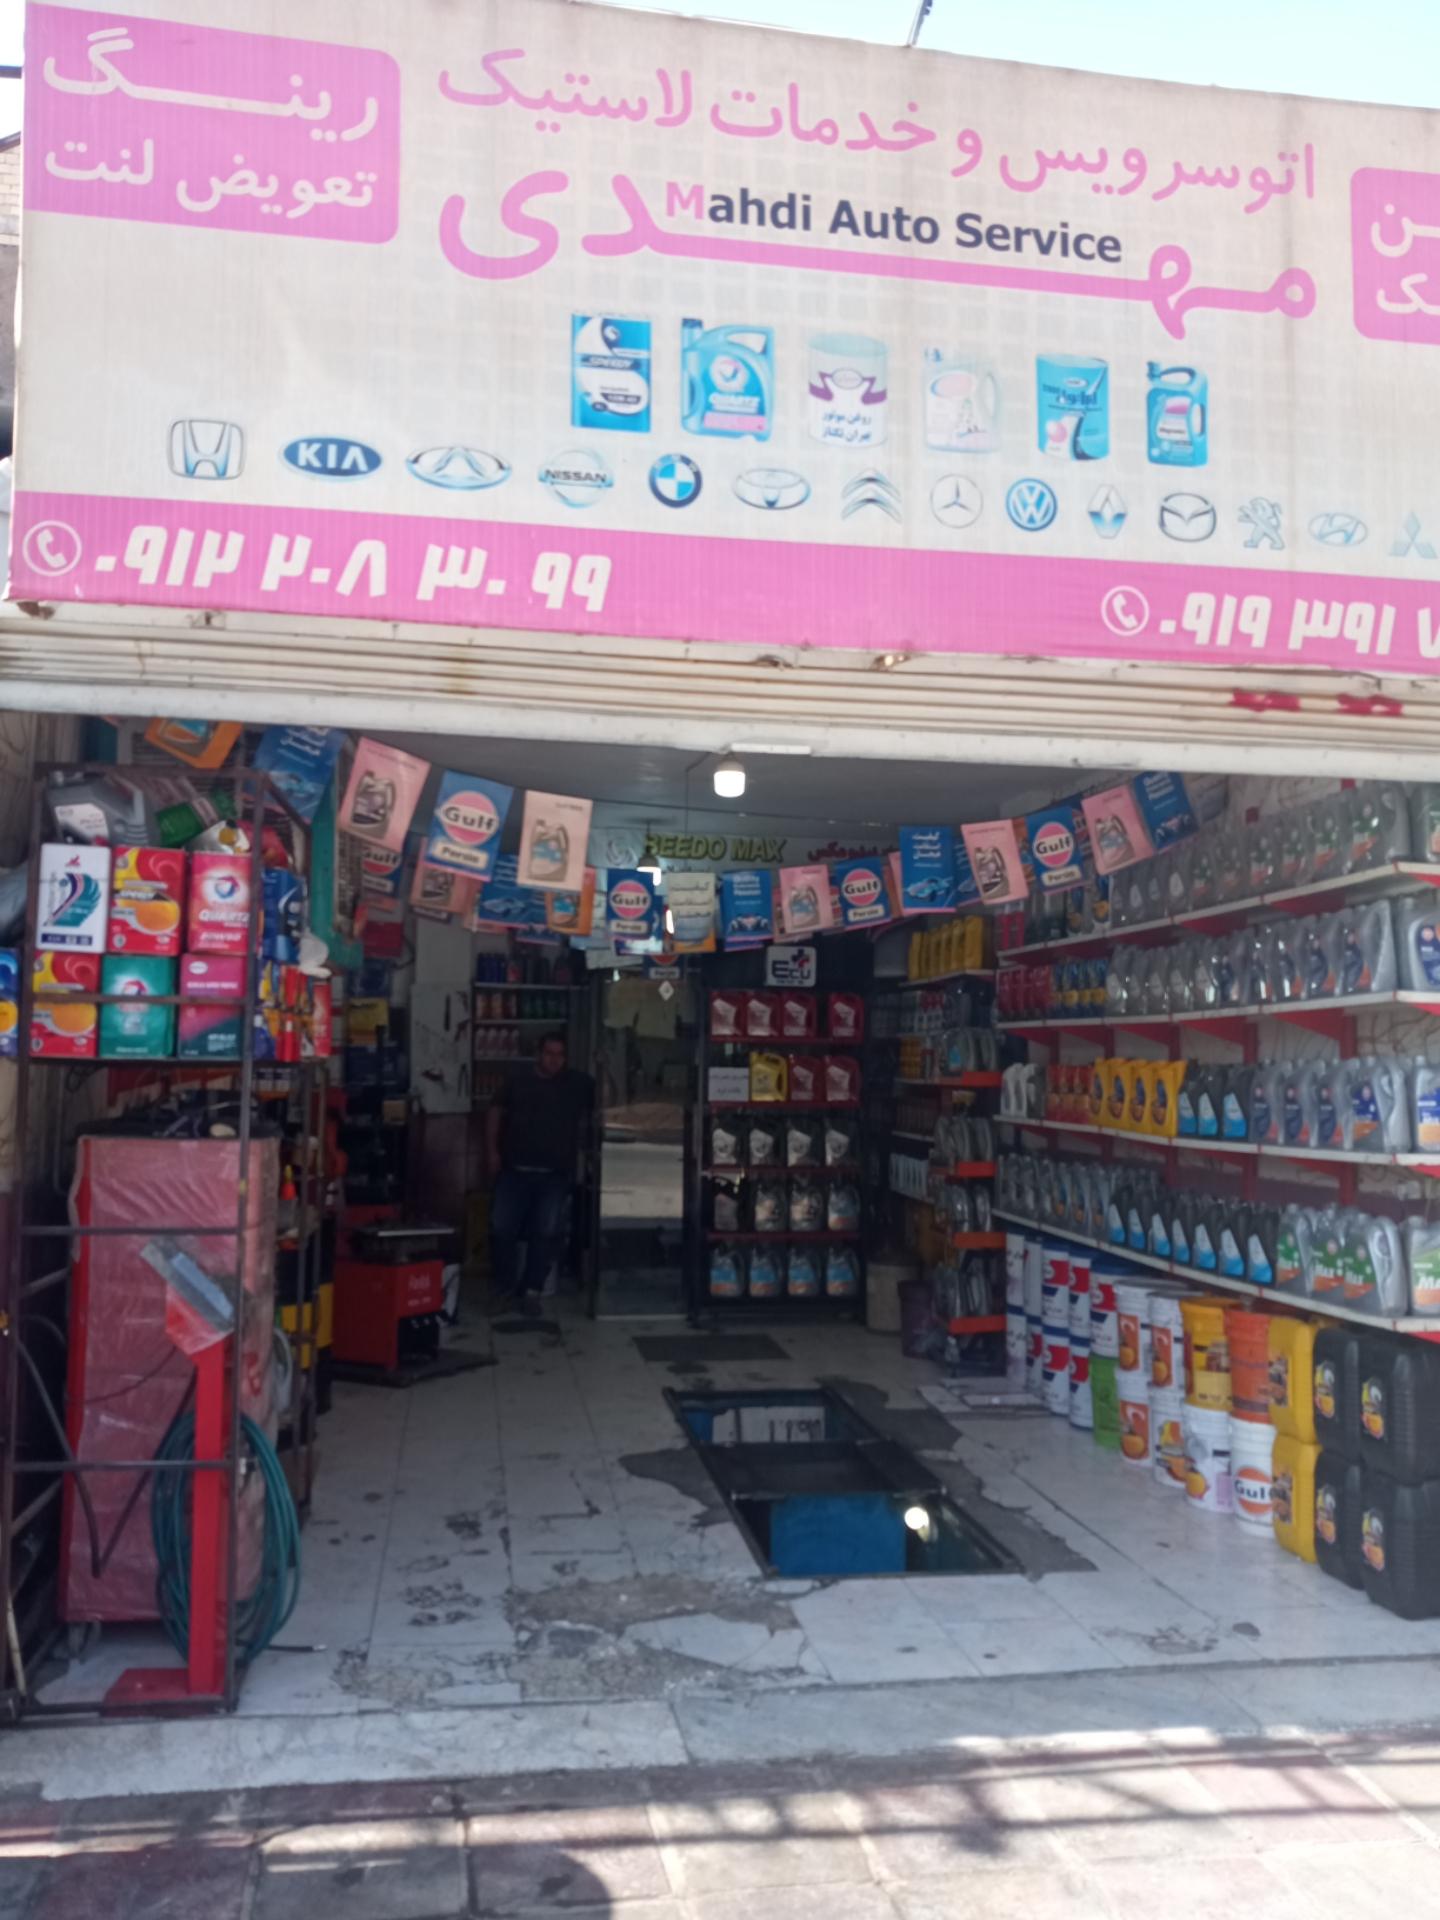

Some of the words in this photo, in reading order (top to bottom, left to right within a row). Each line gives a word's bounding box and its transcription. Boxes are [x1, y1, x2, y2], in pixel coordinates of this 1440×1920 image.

[43, 27, 379, 142] رینگ
[438, 48, 692, 133] لاستیک
[711, 83, 937, 153] خدمات
[45, 139, 155, 186] لنت
[952, 128, 983, 178] و
[176, 154, 378, 219] تعویض
[666, 181, 812, 232] Mahdi
[829, 199, 940, 245] Auto
[955, 212, 1122, 263] Service
[439, 169, 1317, 340] مهدی
[297, 441, 367, 473] KIA
[544, 468, 607, 484] NISSAN
[530, 551, 612, 612] ۹۹
[443, 806, 496, 832] Gulf
[731, 838, 787, 863] MAX
[1035, 836, 1071, 855] Gulf
[611, 892, 648, 906] Gulf
[844, 880, 879, 895] Gulf
[1234, 1479, 1273, 1500] Gul
